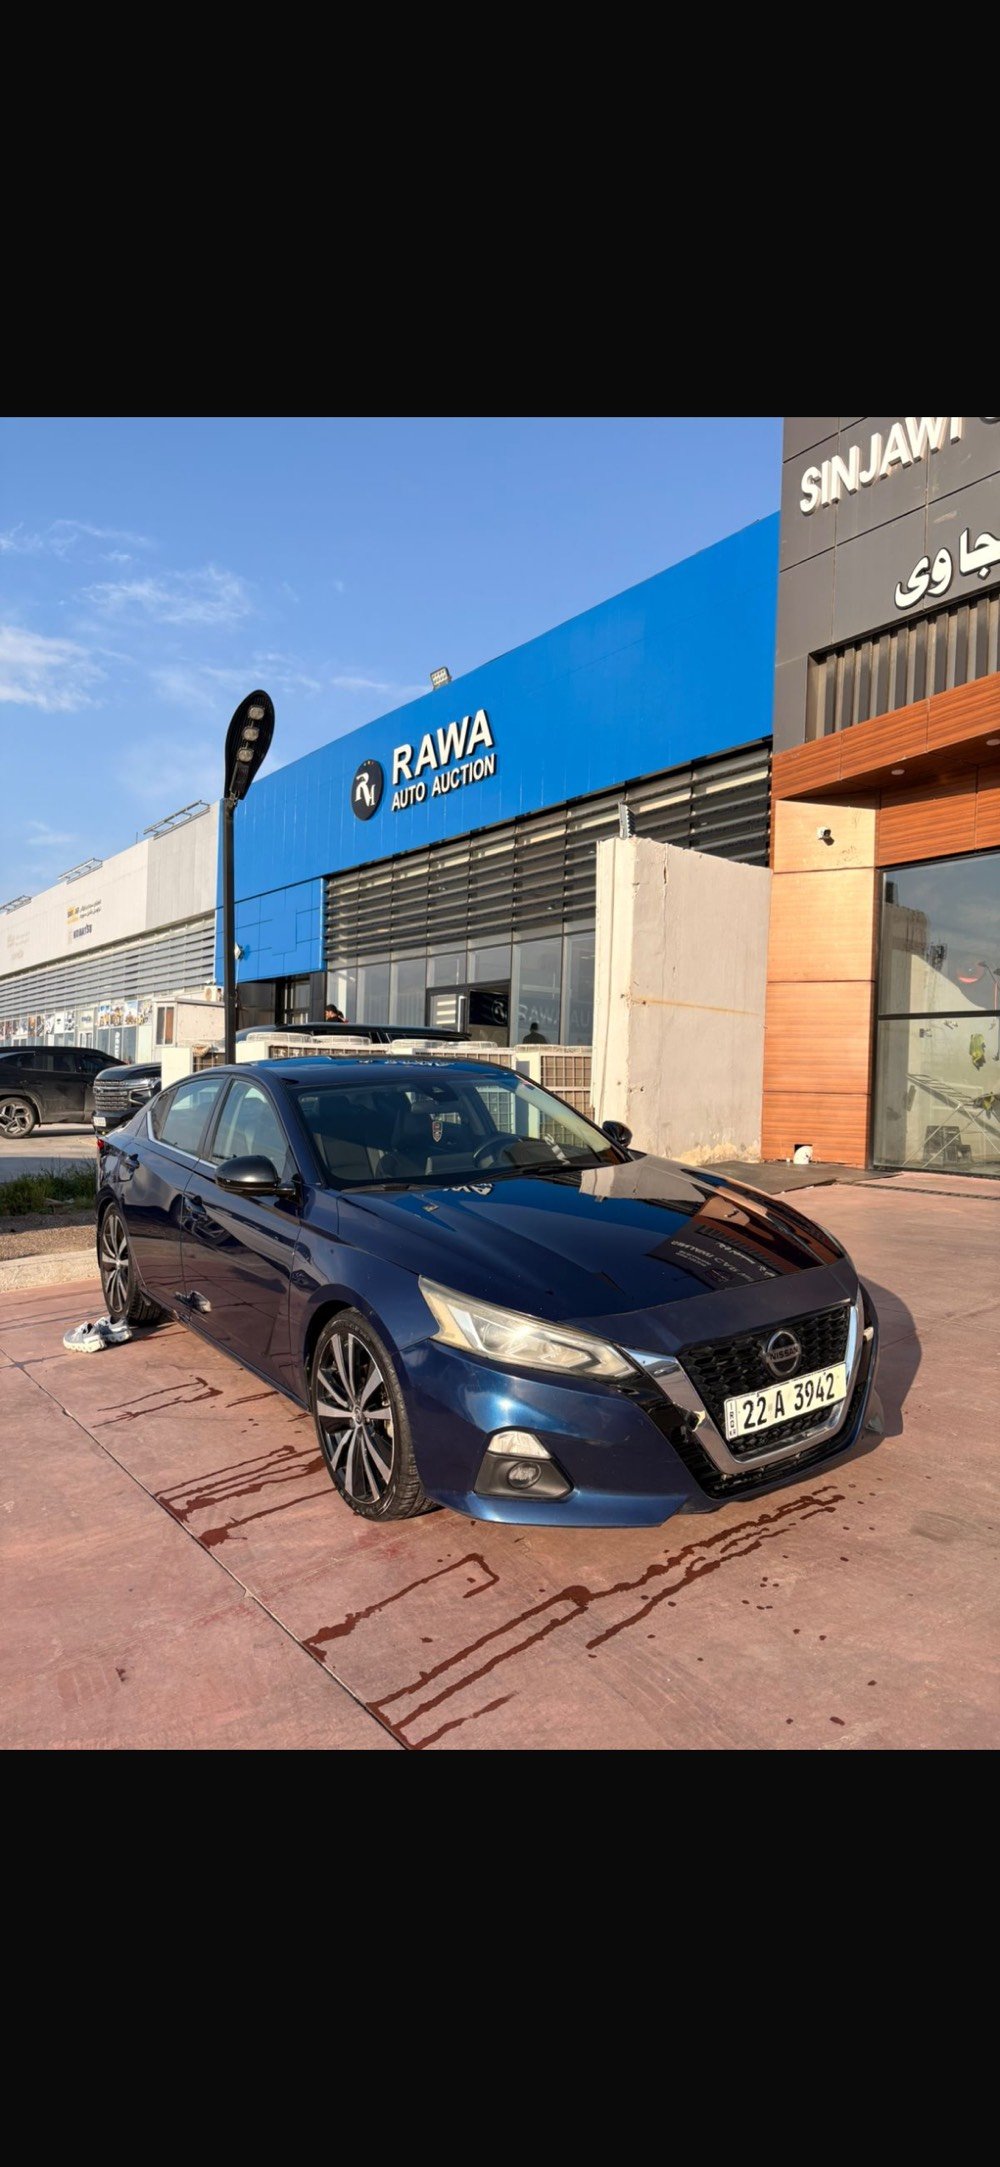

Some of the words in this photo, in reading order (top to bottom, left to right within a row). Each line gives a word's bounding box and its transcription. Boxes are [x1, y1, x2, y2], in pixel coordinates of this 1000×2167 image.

[392, 708, 495, 785] RAWA
[392, 781, 427, 812] AUTO
[431, 753, 496, 797] AUCTION
[769, 1345, 799, 1361] NISSAN
[742, 1396, 767, 1430] 22
[774, 1390, 785, 1418] A
[794, 1372, 835, 1411] 3942
